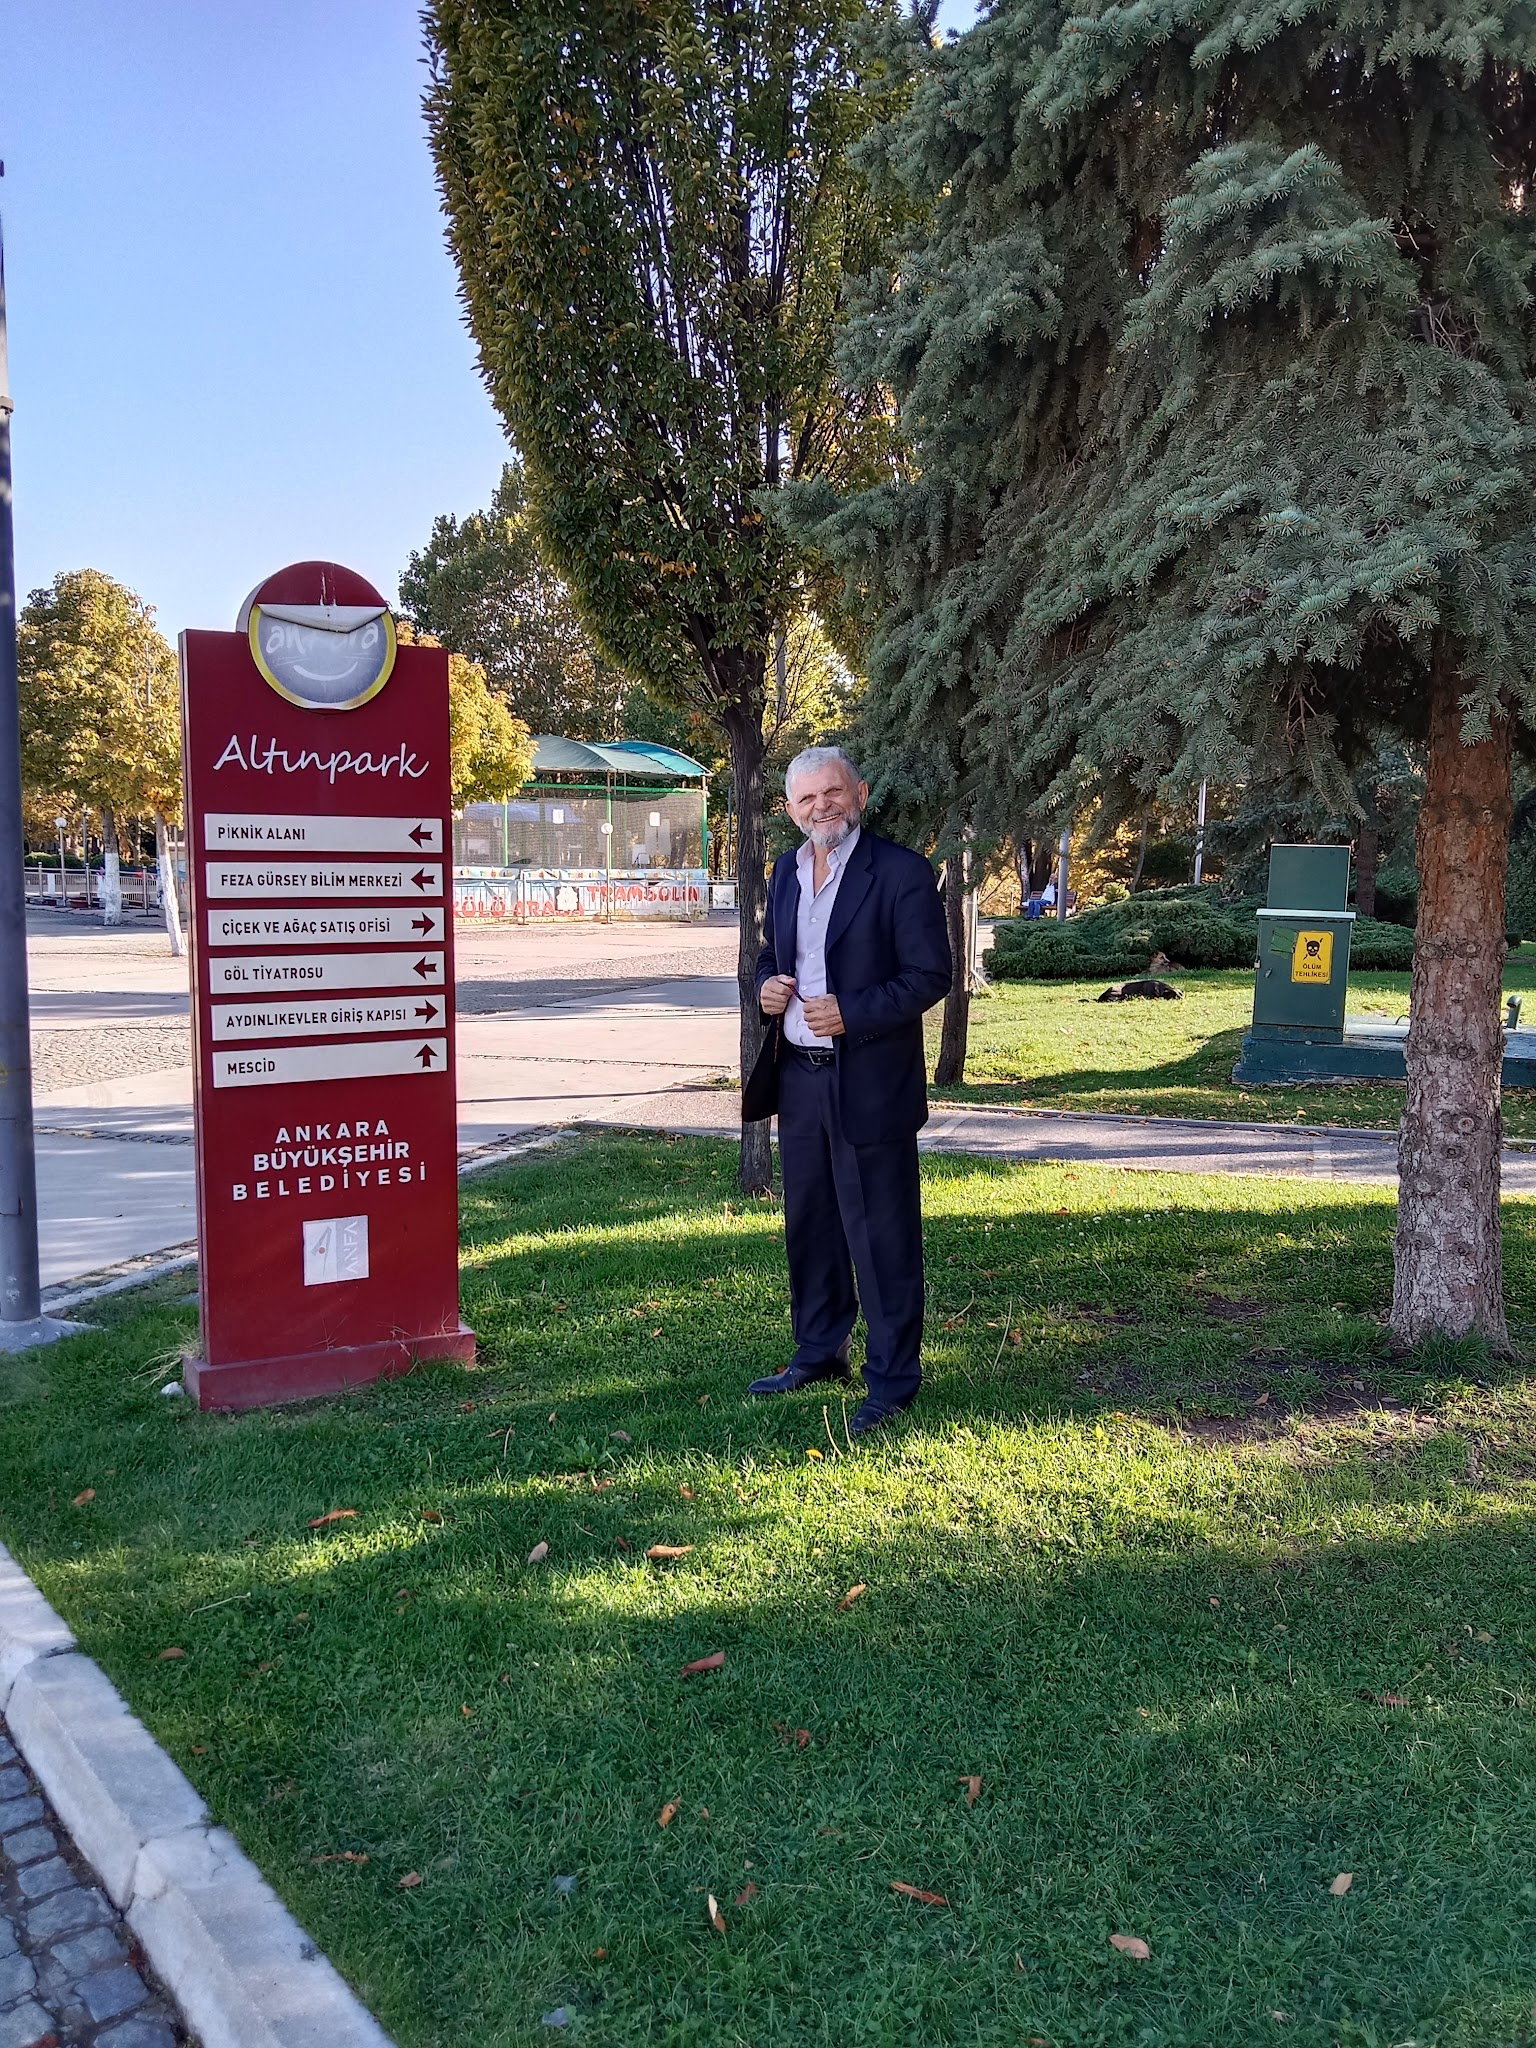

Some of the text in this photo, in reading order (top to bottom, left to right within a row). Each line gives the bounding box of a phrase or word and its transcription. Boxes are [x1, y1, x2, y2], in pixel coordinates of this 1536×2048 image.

[213, 734, 430, 785] Altınpark
[217, 823, 306, 841] PİKNİK ALANI
[221, 871, 403, 888] FEZA GÜRSEY BİLİM MERKEZİ
[222, 918, 391, 937] ÇİÇEK VE AĞAÇ SATIŞ OFİSİ
[224, 964, 324, 981] GÖL TİYATROSU
[226, 1008, 407, 1028] AYDINLIKEVLER GİRİŞ KAPISI
[227, 1058, 276, 1075] MESCİD
[275, 1120, 389, 1144] ANKARA
[253, 1139, 410, 1172] BÜYÜKŞEHİR
[232, 1161, 426, 1201] BELEDİYESİ
